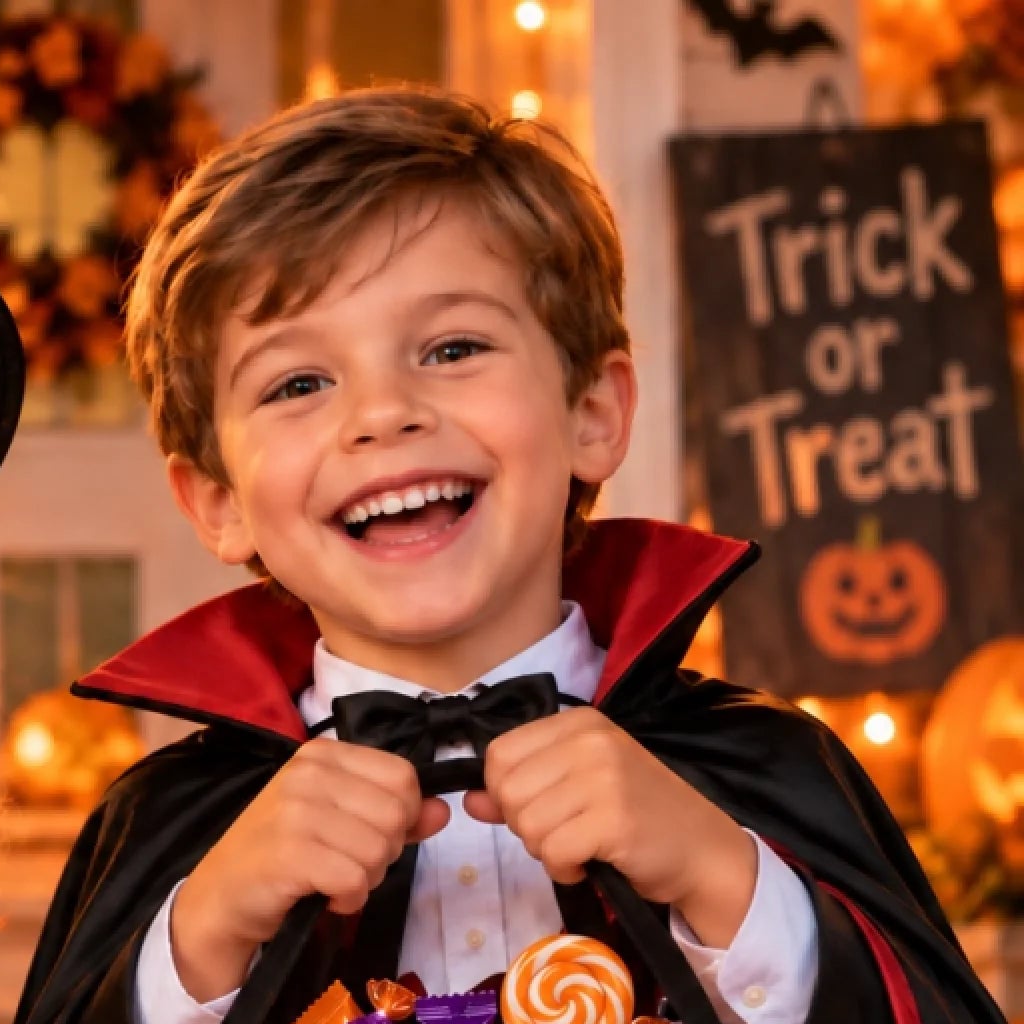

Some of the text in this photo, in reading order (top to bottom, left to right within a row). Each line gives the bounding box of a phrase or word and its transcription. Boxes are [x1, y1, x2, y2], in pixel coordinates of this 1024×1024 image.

[705, 166, 974, 326] Trick
[806, 317, 898, 394] or
[719, 363, 993, 527] Treat
